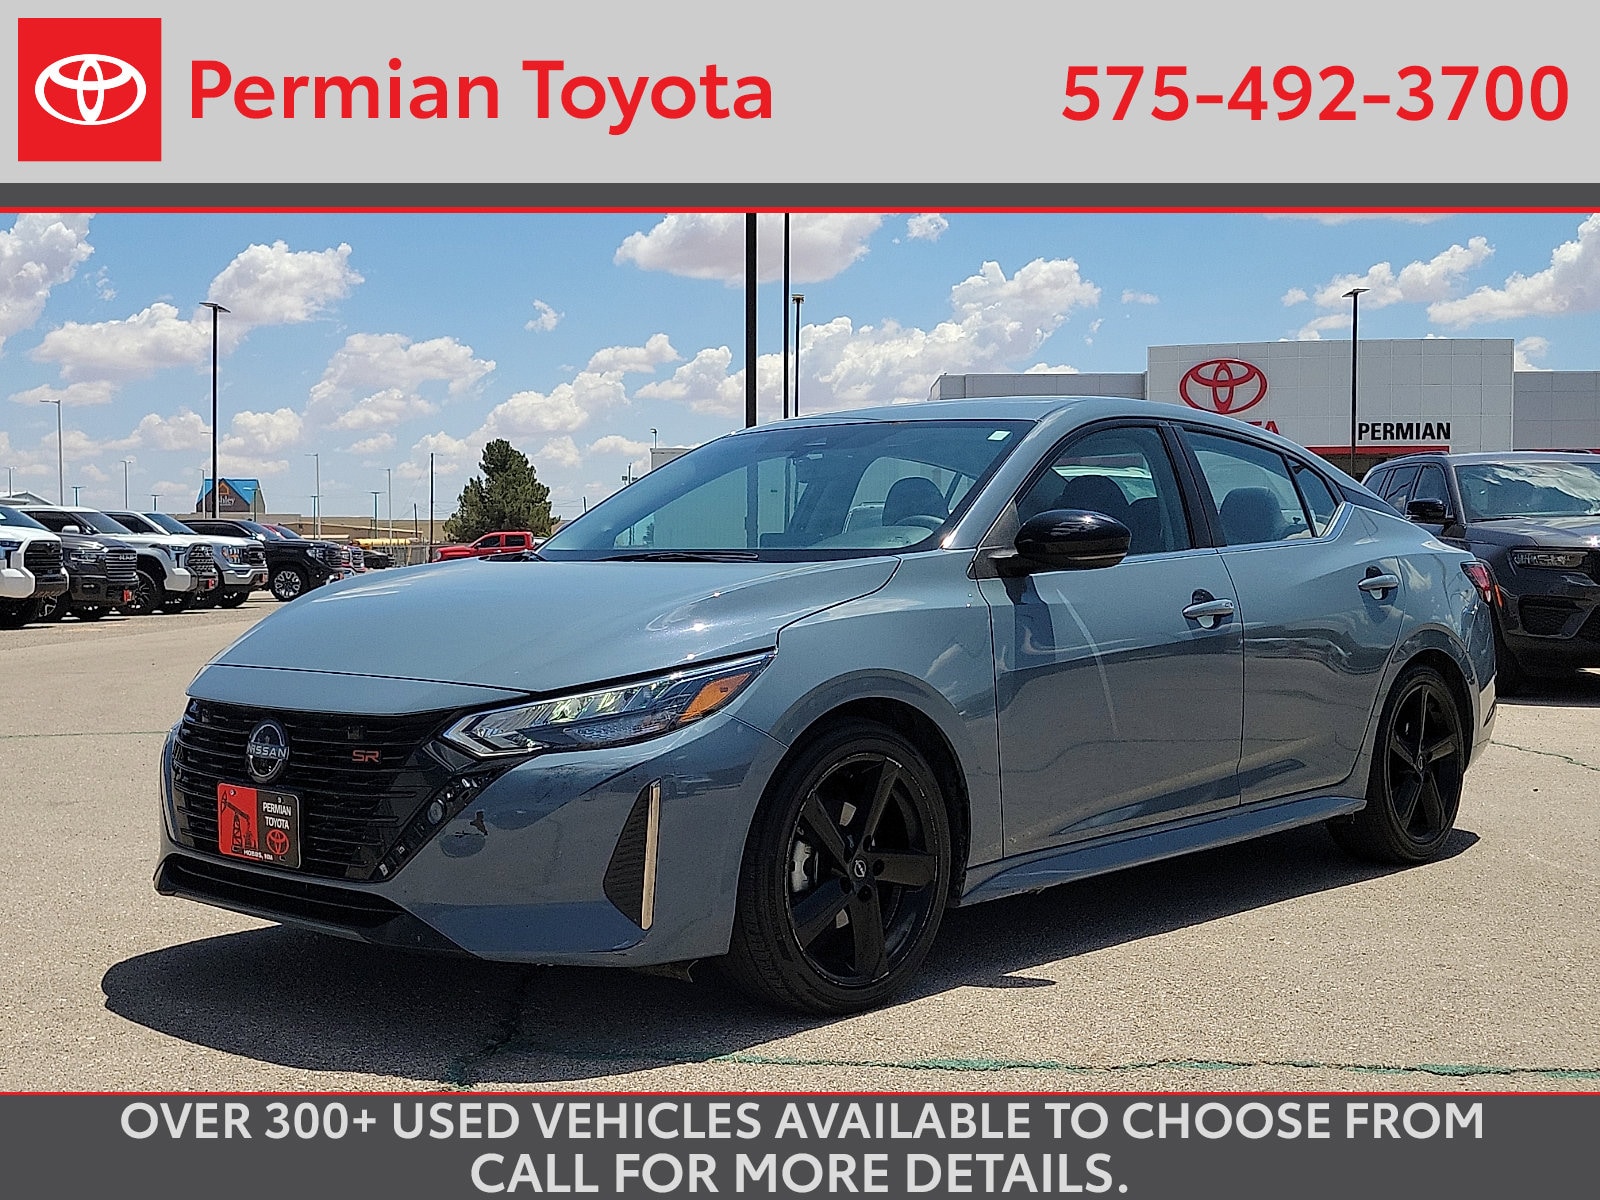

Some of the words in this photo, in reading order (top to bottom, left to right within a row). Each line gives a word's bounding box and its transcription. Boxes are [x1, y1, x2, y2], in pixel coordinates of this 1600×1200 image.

[1357, 422, 1451, 441] PERMIAN
[247, 742, 288, 759] NISSAN
[352, 750, 379, 762] SR
[262, 802, 292, 816] PERMIAN
[264, 816, 290, 830] TOYOTA
